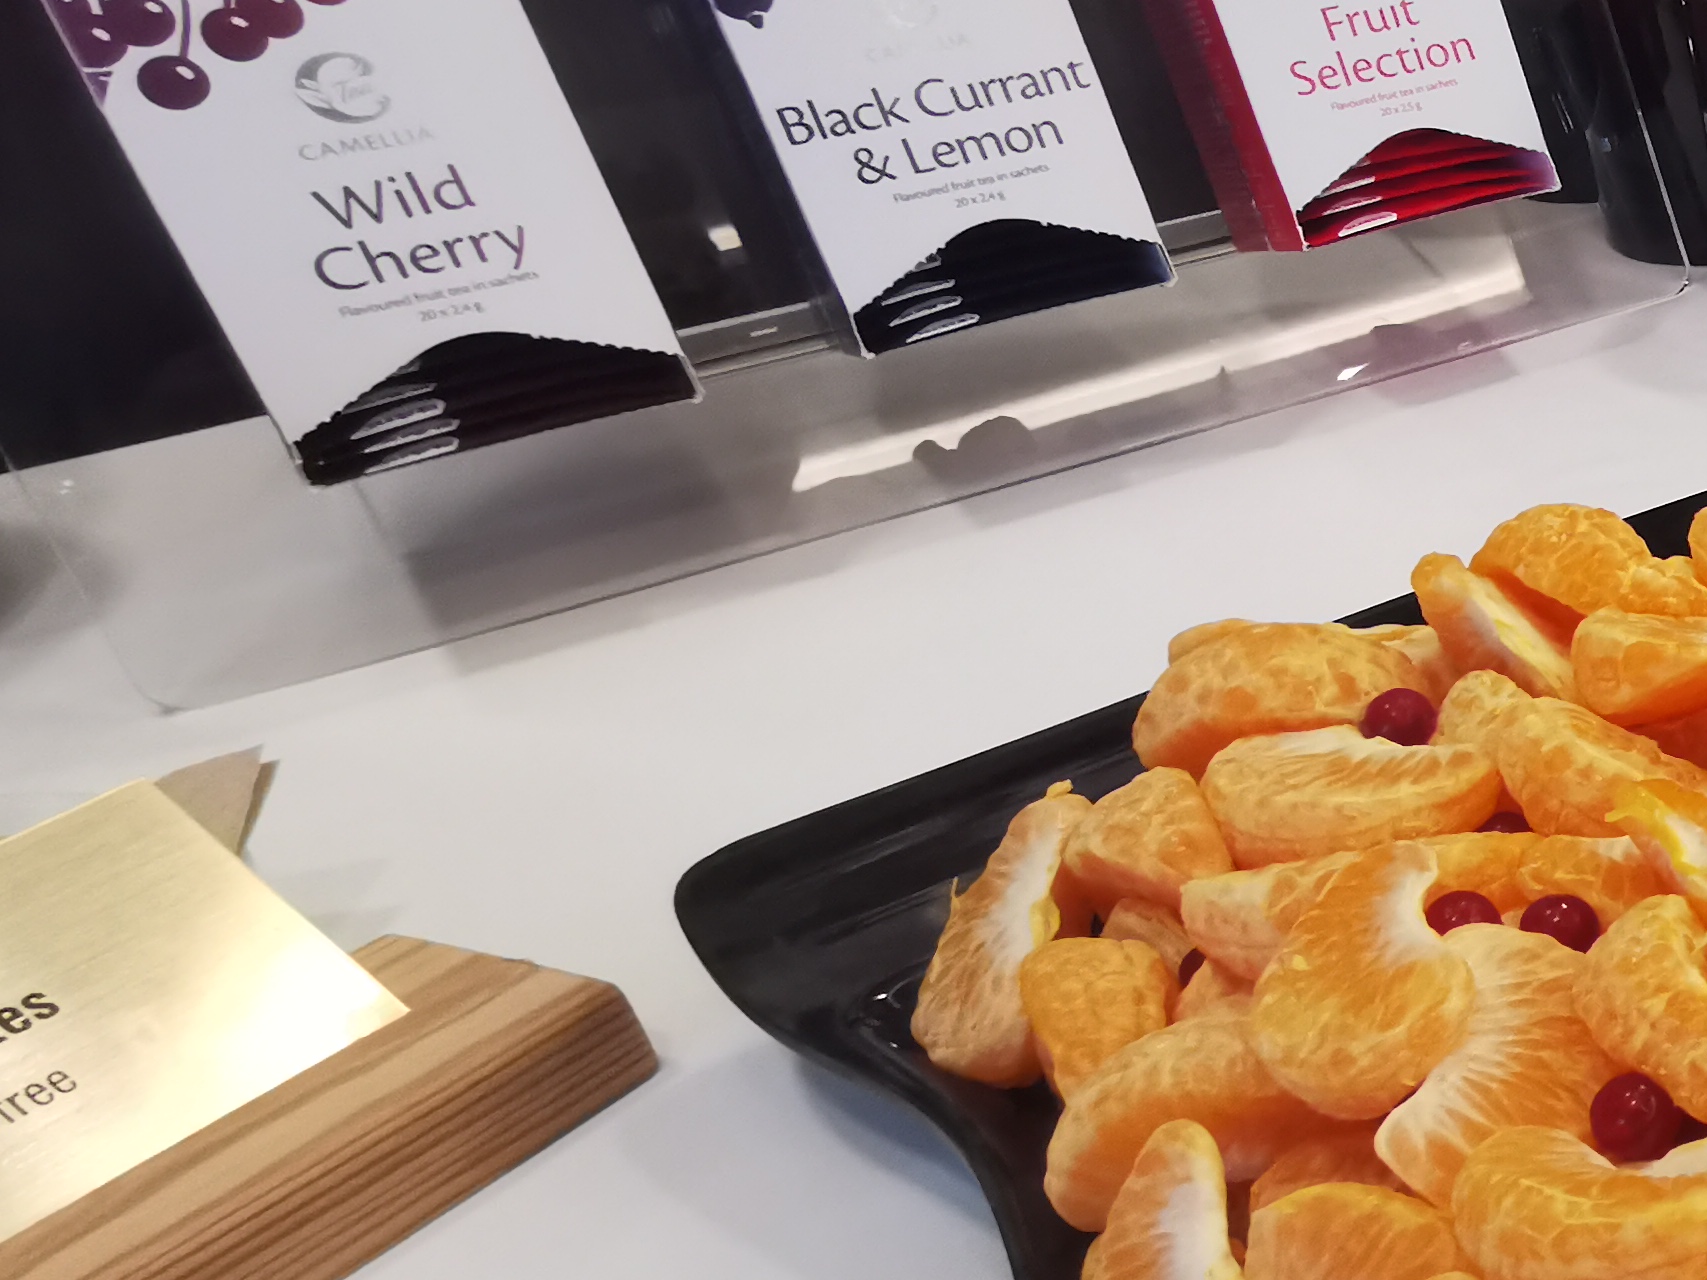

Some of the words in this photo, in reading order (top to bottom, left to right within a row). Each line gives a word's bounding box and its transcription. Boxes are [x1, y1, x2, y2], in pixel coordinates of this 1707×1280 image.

[1289, 35, 1478, 97] Selection
[775, 87, 910, 147] Black
[914, 60, 1092, 117] Currant
[298, 127, 435, 160] CAMELLIA
[852, 146, 897, 185] &
[901, 120, 1065, 175] Lemon
[310, 163, 476, 230] Wild
[954, 197, 970, 208] 20
[314, 225, 525, 290] Cherry
[0, 992, 60, 1044] es
